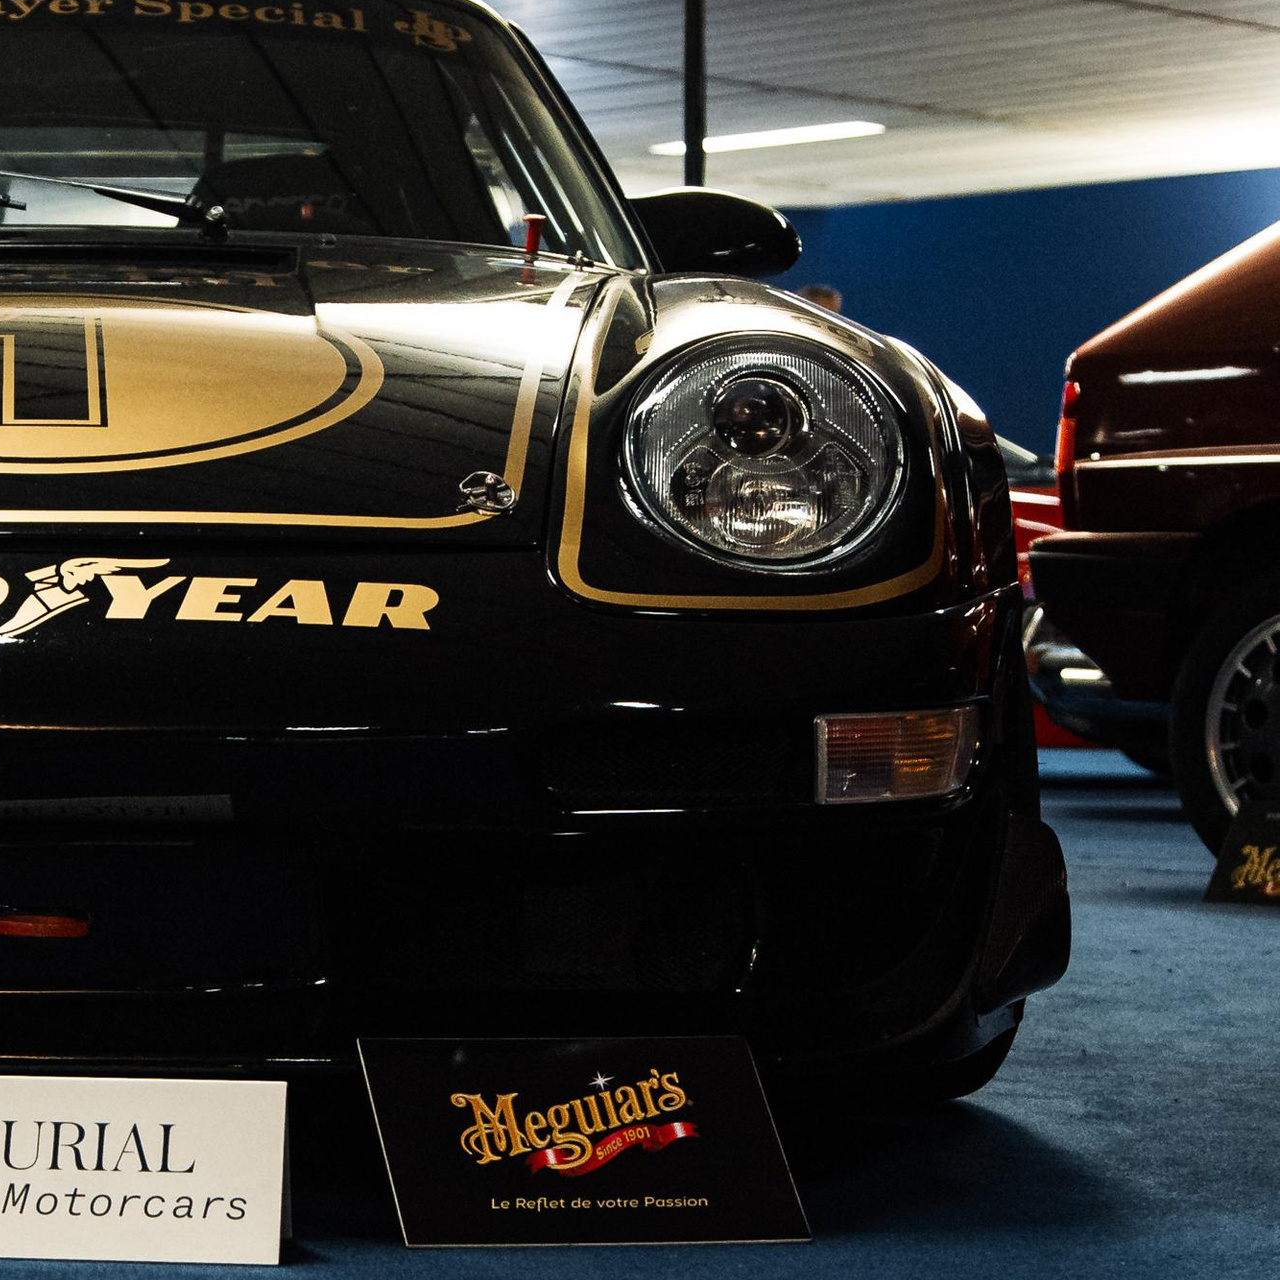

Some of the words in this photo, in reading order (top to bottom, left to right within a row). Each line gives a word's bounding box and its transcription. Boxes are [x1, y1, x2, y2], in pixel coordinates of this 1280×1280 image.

[102, 574, 441, 631] YEAR
[450, 1068, 687, 1170] Meguiar's
[595, 1137, 623, 1161] Since
[624, 1126, 652, 1143] 1901
[491, 1197, 511, 1209] Le
[516, 1197, 566, 1212] Reflet
[571, 1197, 591, 1209] de
[597, 1198, 639, 1209] votre
[644, 1195, 709, 1208] Passion
